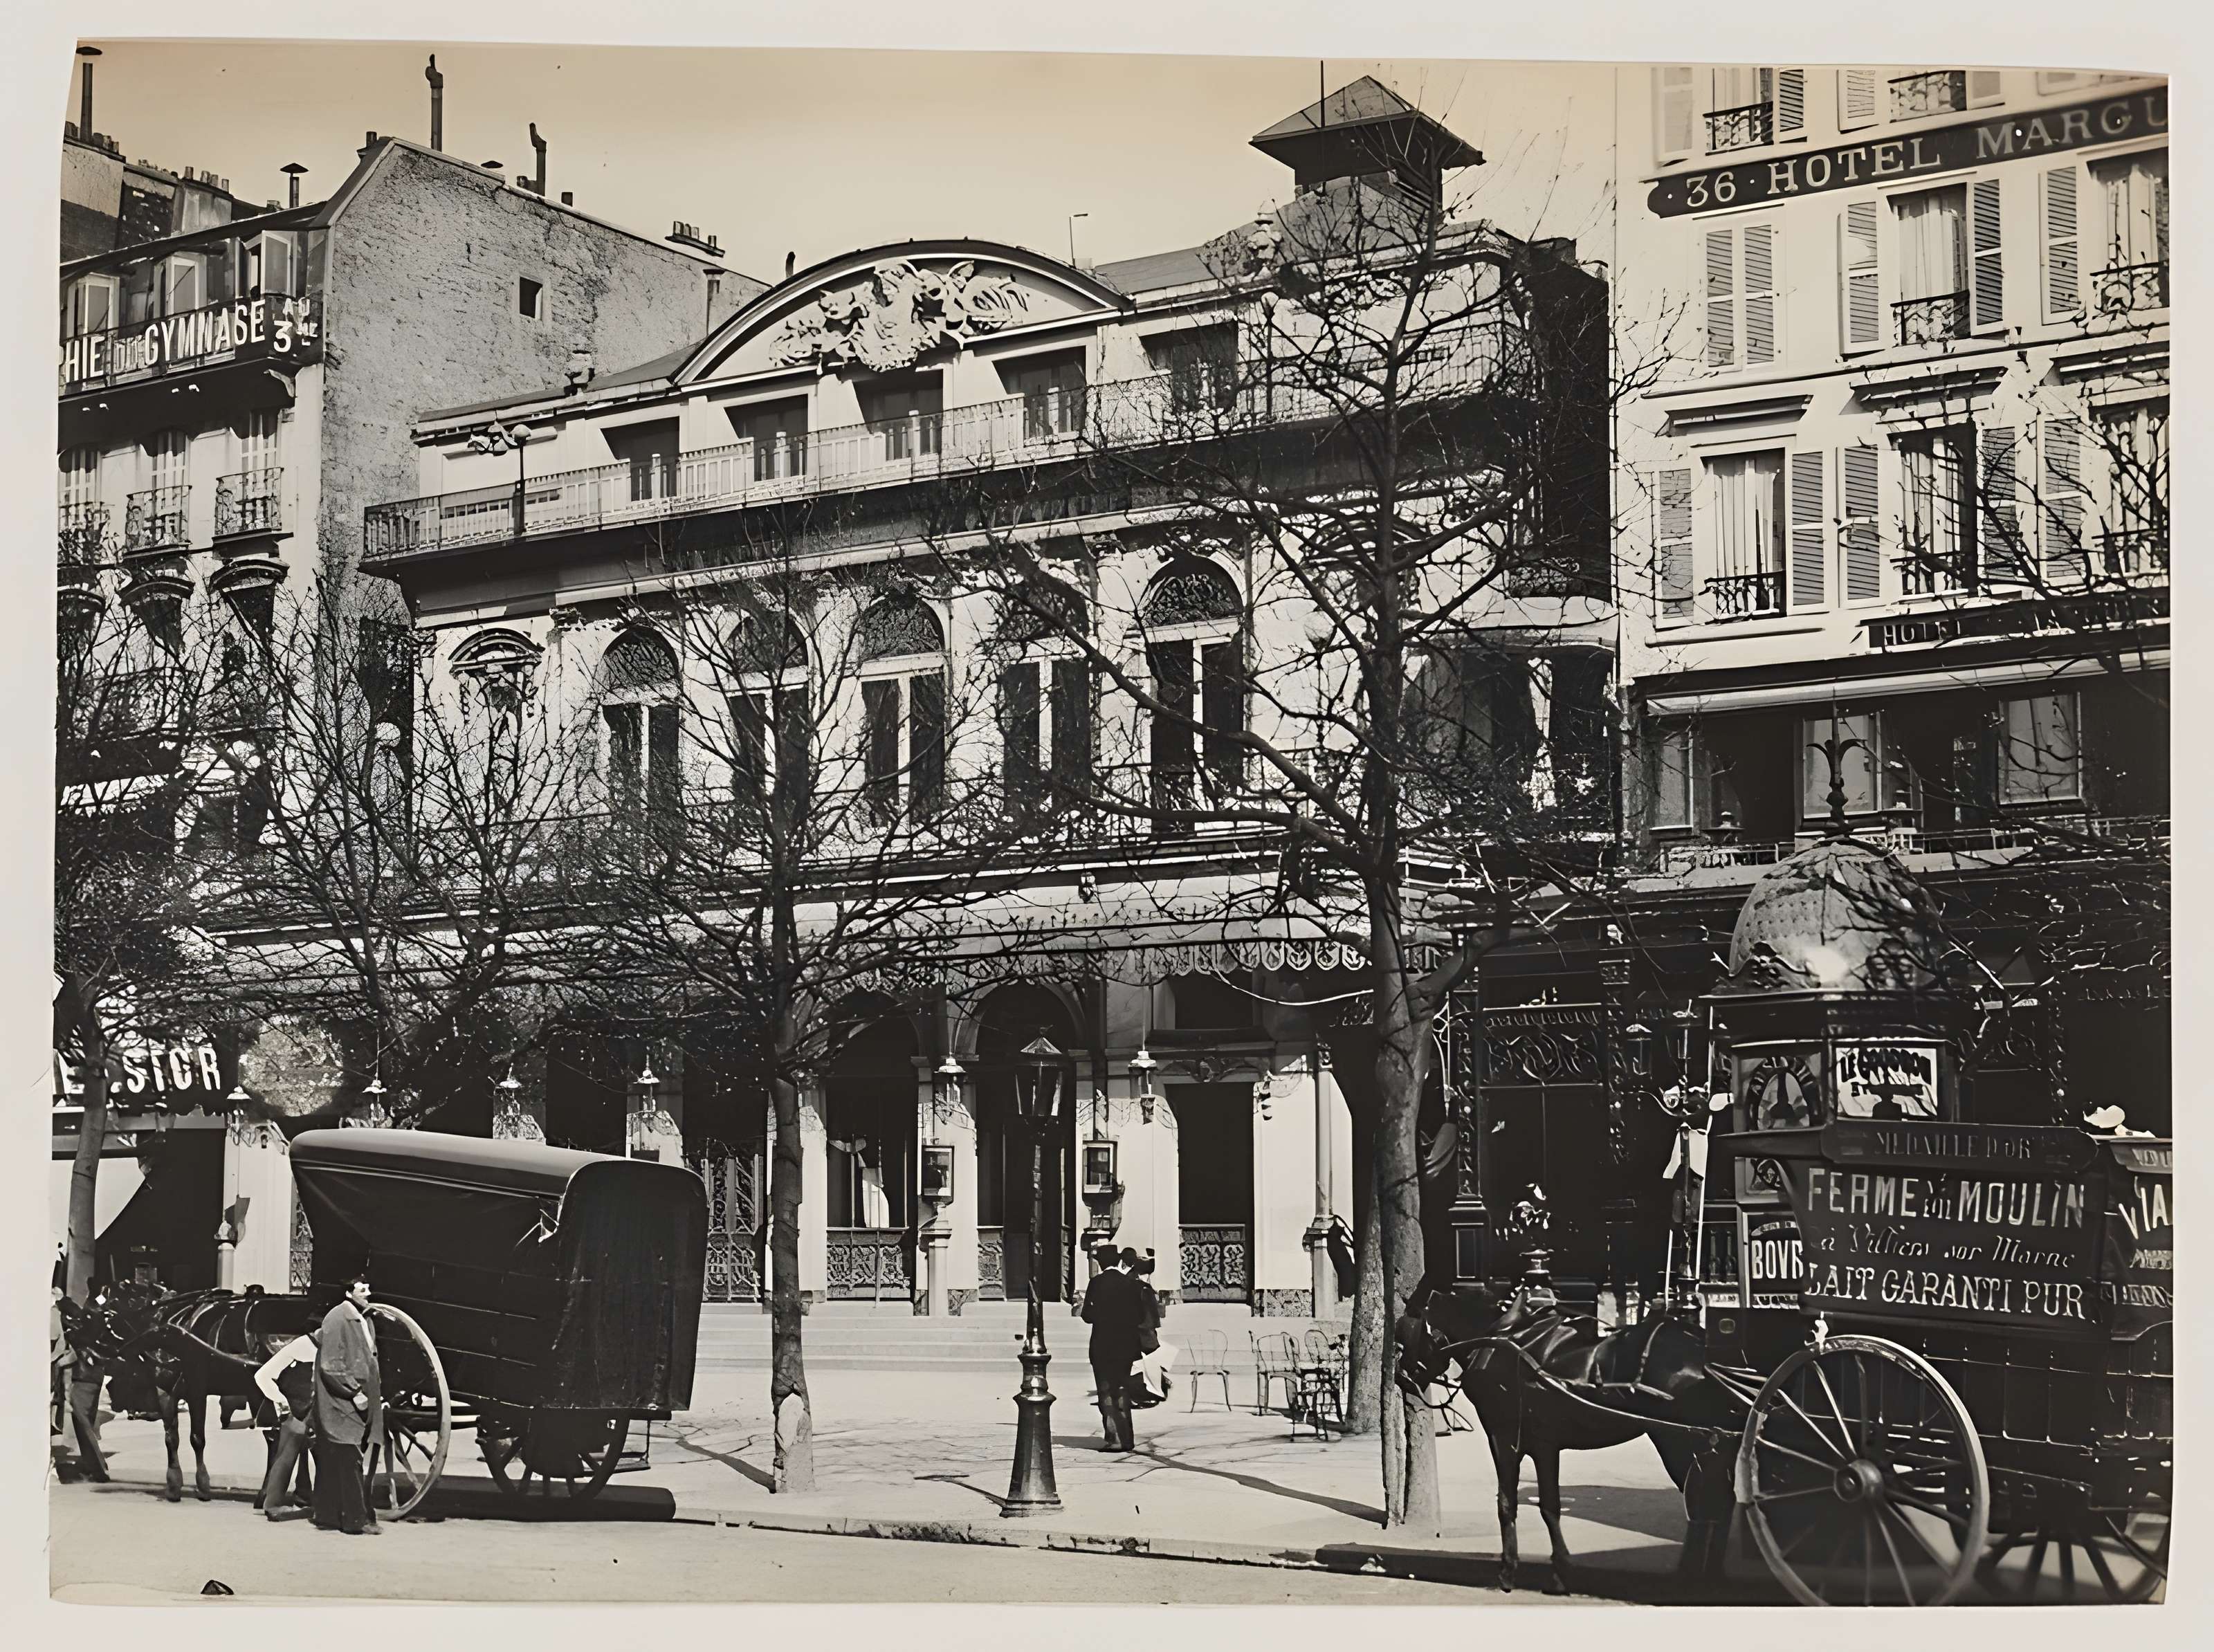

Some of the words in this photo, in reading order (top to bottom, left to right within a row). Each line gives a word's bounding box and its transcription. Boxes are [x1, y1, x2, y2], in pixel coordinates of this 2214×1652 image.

[1685, 171, 1737, 207] 36
[1766, 137, 1941, 194] HOTEL
[144, 299, 266, 366] GYMNASE
[1808, 1167, 1919, 1217] FERME
[1957, 1180, 2085, 1229] MOULIN
[1804, 1262, 1876, 1301] LAIT
[1881, 1269, 2013, 1313] GARANTI
[2020, 1279, 2086, 1320] PUR
